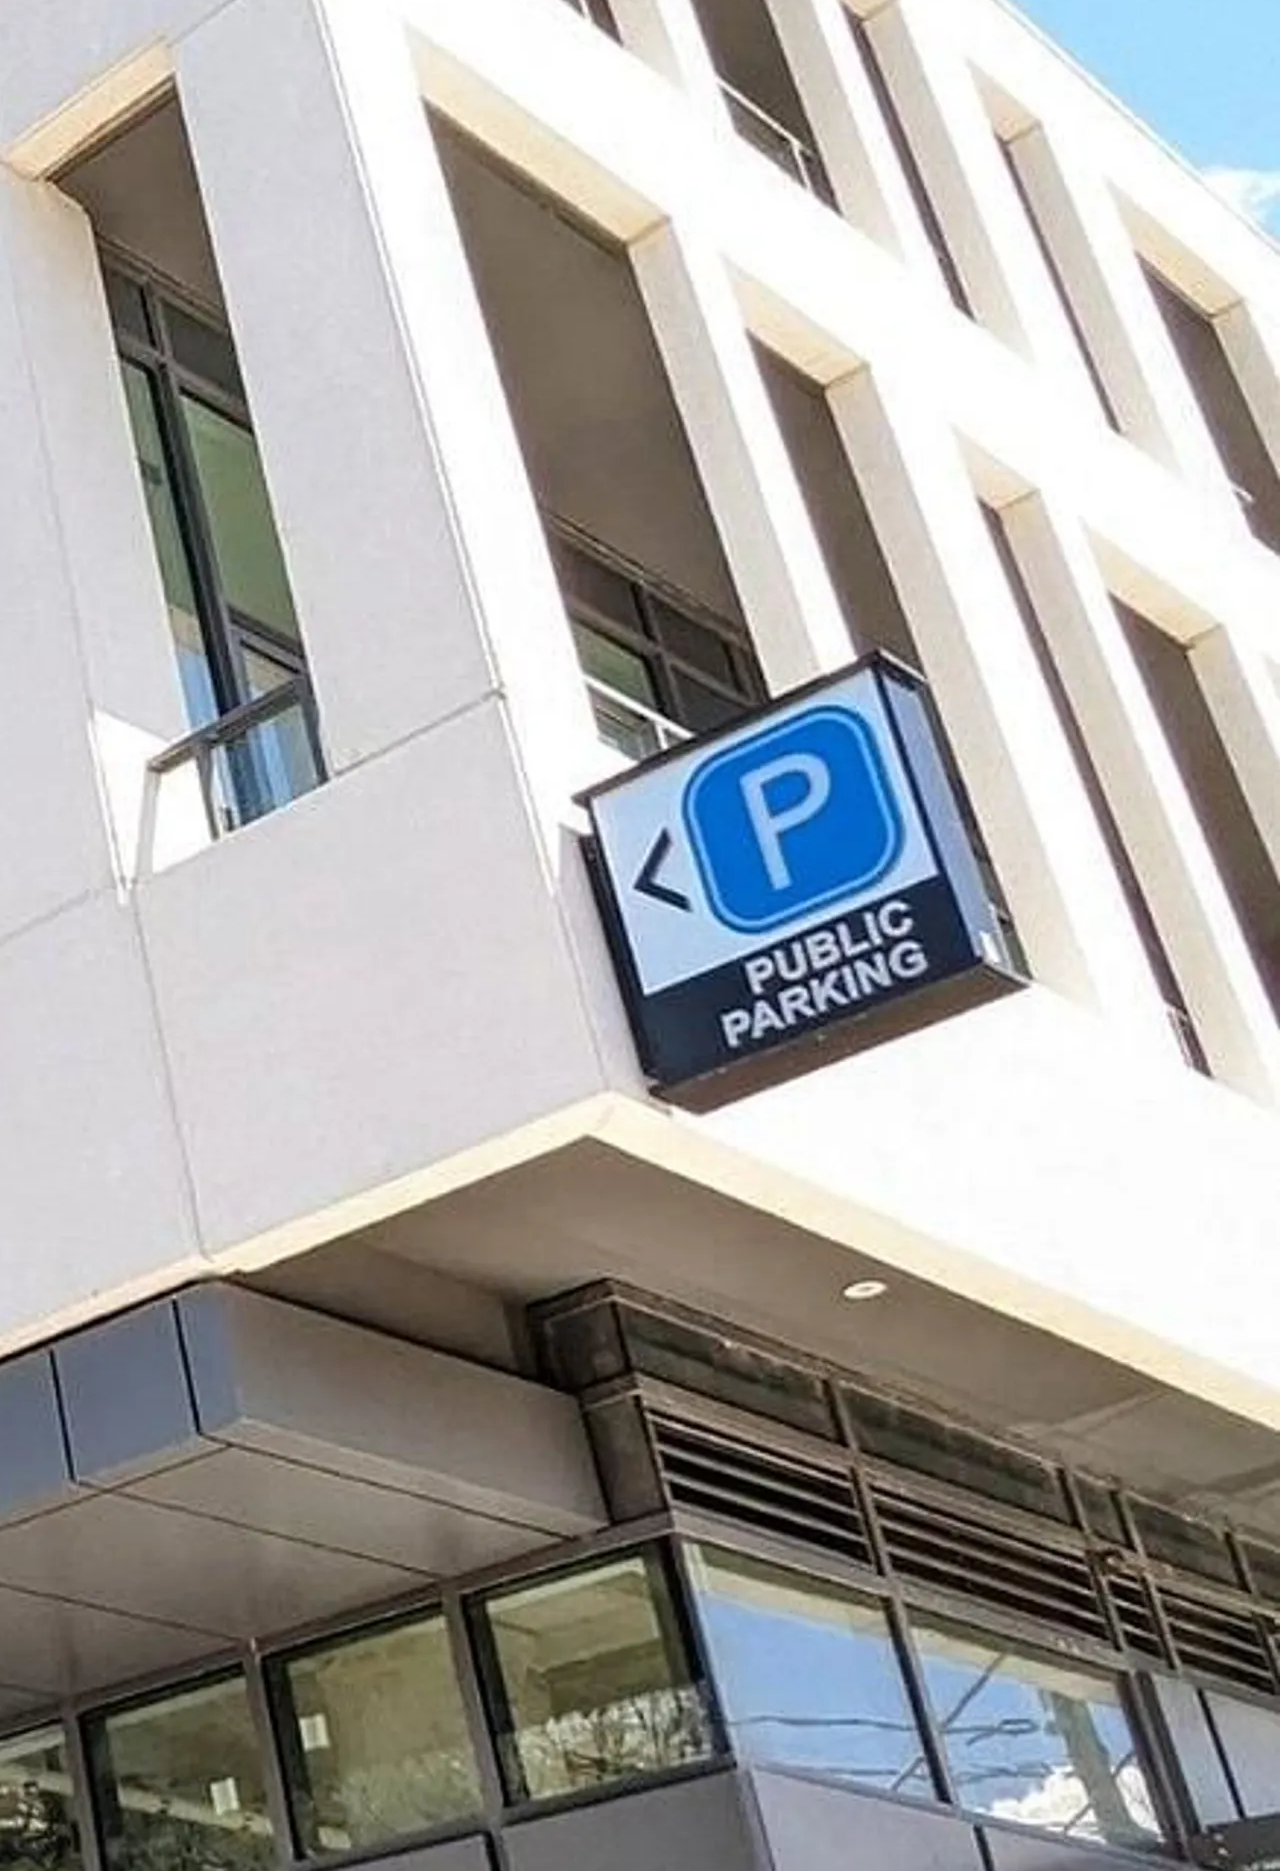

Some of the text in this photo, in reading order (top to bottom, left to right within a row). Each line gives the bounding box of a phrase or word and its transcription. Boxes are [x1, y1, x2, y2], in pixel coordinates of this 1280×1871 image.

[740, 752, 831, 891] P
[720, 941, 929, 1047] PARKING
[745, 901, 915, 996] PUBLIC
